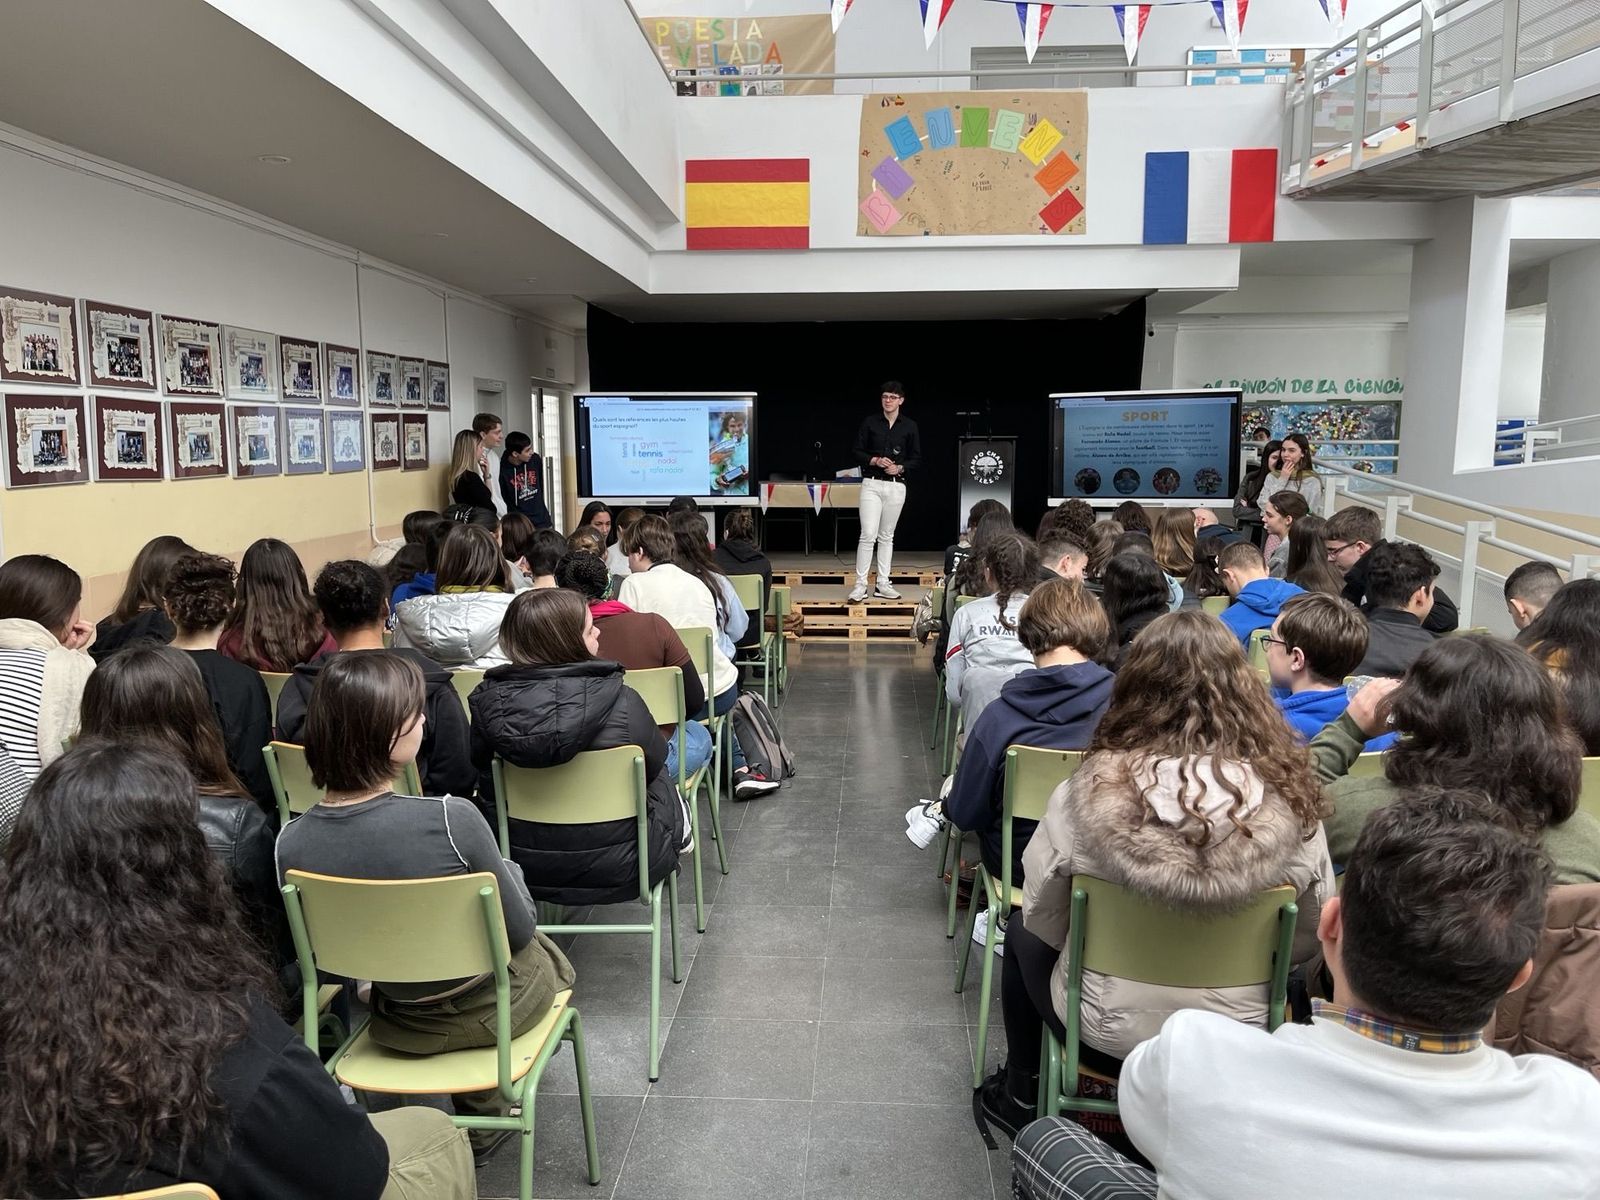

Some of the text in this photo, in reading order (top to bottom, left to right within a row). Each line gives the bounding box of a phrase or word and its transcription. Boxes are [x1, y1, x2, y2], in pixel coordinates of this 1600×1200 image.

[655, 18, 763, 45] POESIA
[1122, 410, 1169, 422] SPORT
[638, 449, 663, 458] tennis
[640, 441, 659, 450] gym
[970, 451, 984, 475] CAMPO
[986, 450, 1004, 475] CHARRO
